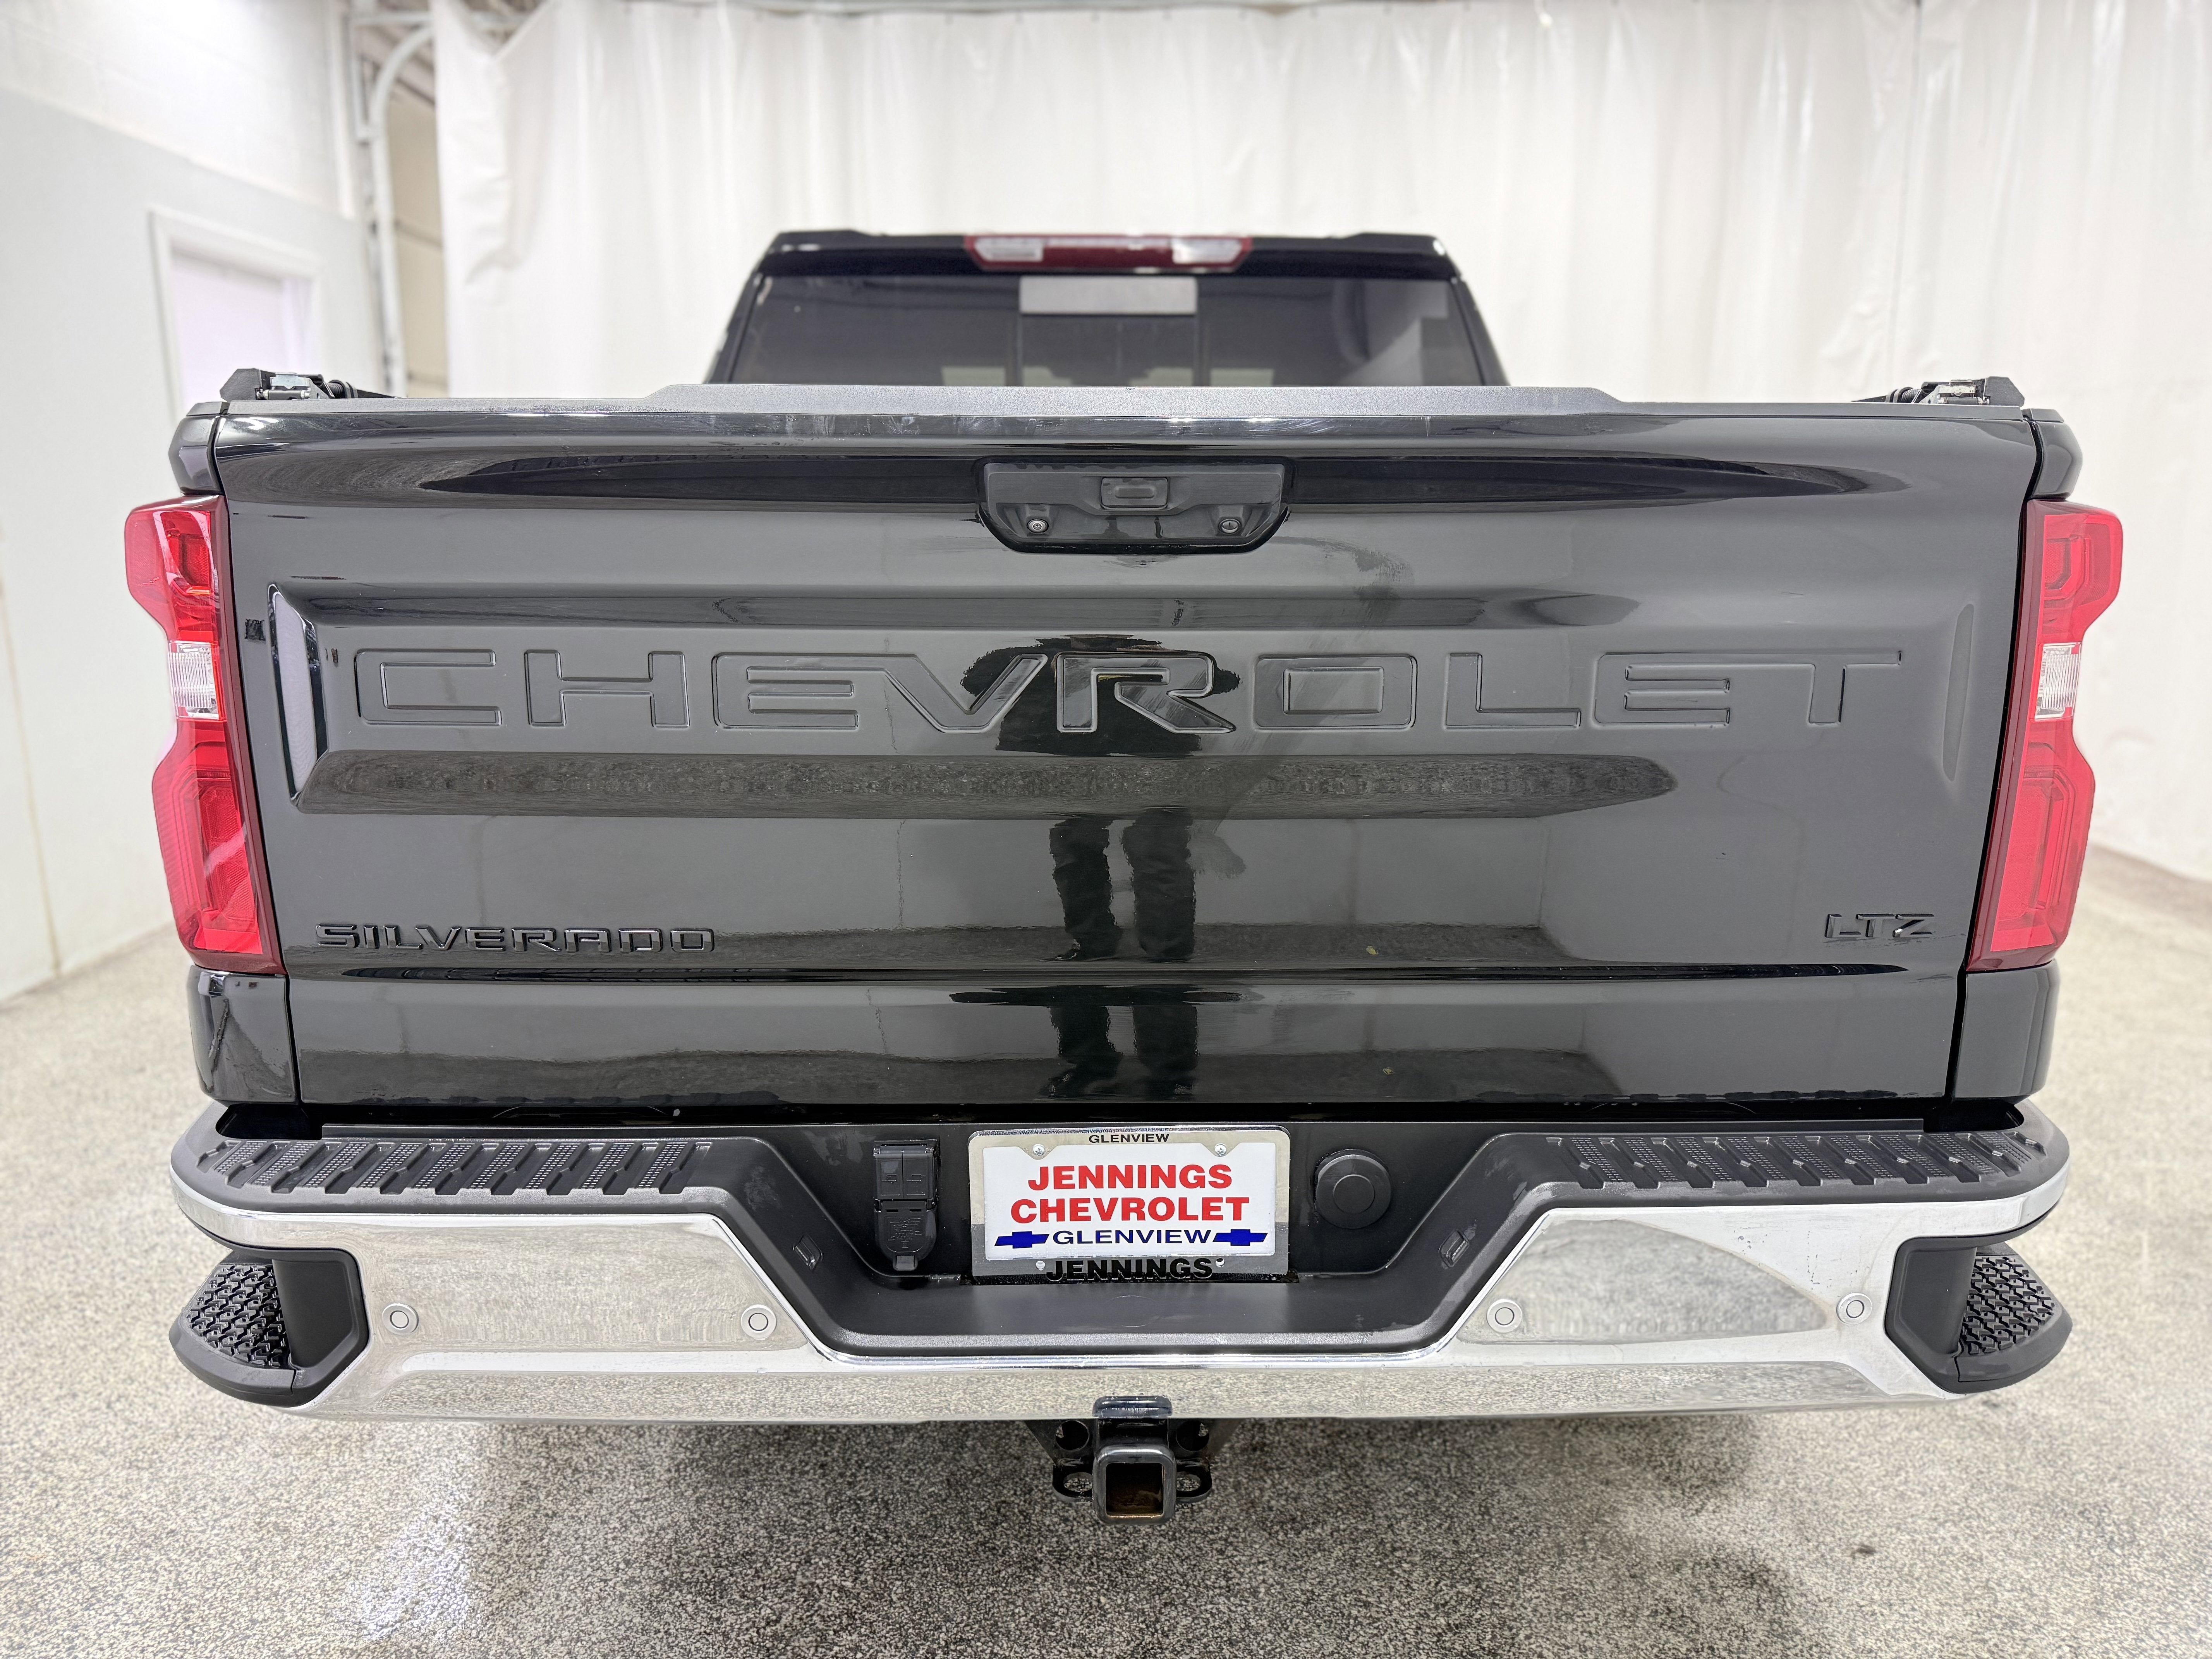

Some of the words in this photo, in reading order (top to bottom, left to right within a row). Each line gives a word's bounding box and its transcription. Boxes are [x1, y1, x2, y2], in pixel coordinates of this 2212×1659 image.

[354, 648, 1903, 734] CHEVROLET
[315, 922, 716, 953] SILVERADO
[1824, 913, 1935, 938] LTZ
[1089, 1133, 1170, 1143] GLENVIEW
[1028, 1164, 1232, 1190] JENNINGS
[1011, 1197, 1249, 1223] CHEVROLET
[1053, 1229, 1212, 1245] GLENVIEW
[1046, 1257, 1213, 1281] JENNINGS
